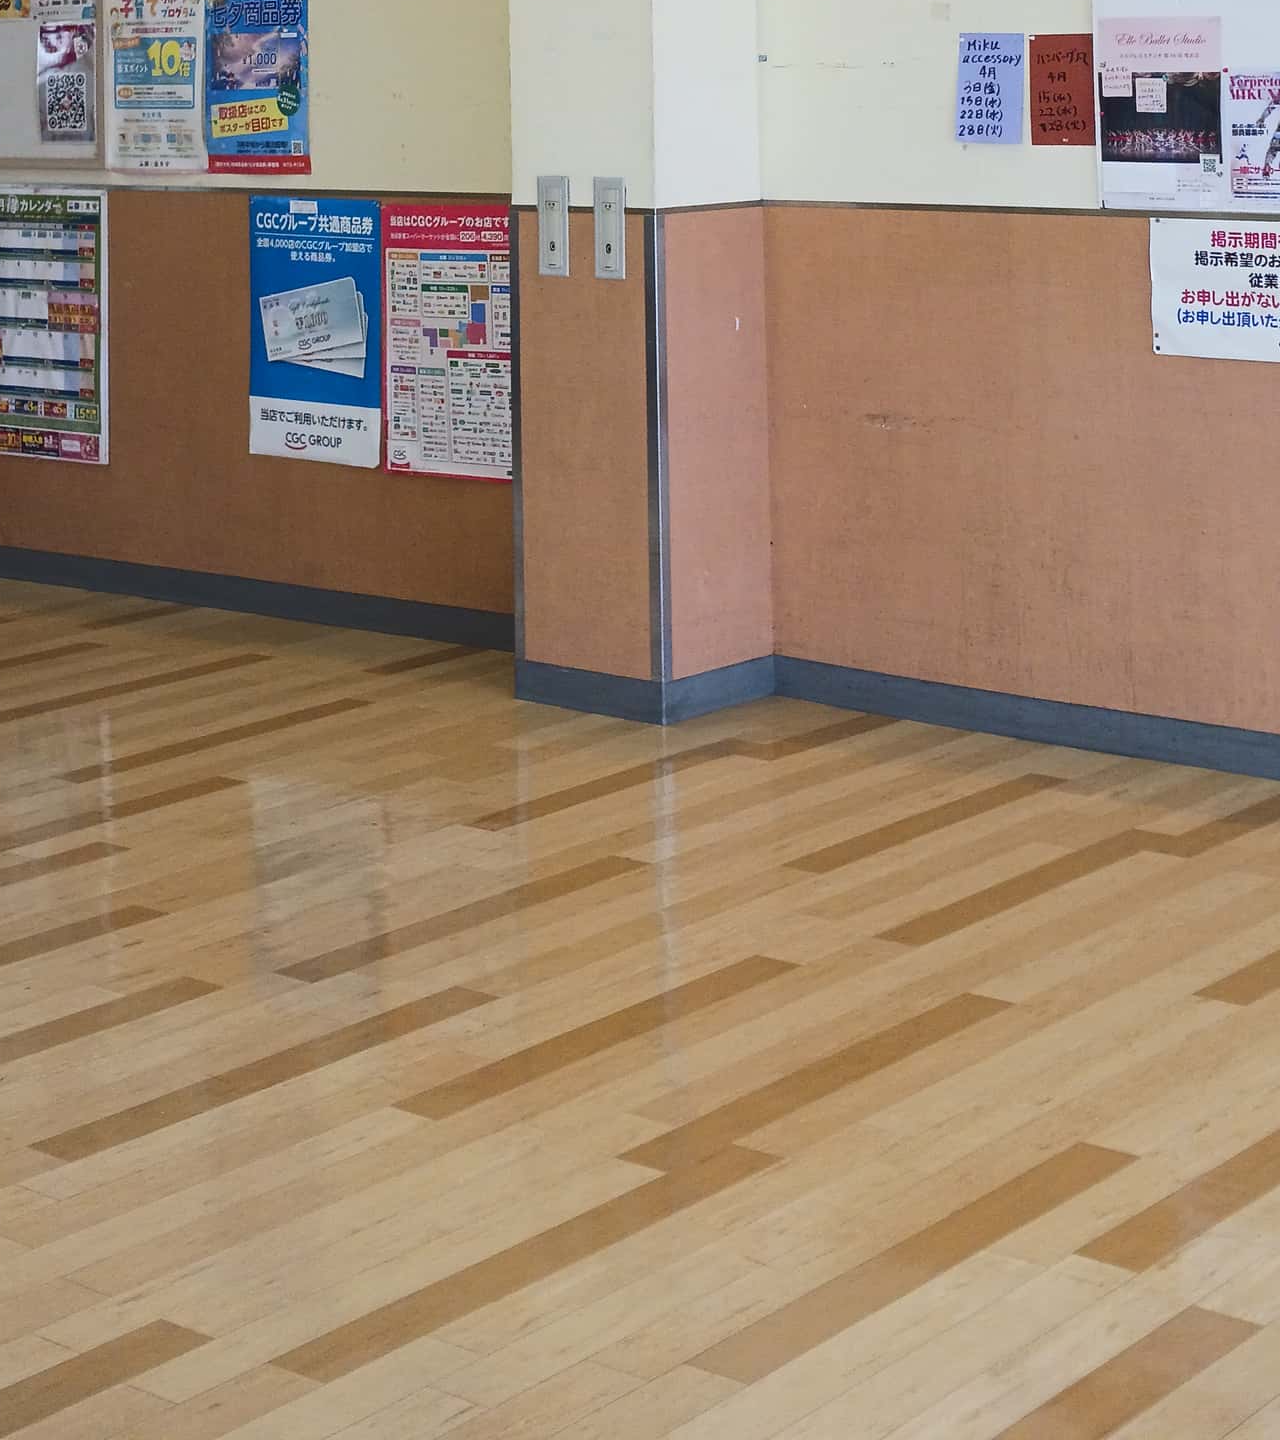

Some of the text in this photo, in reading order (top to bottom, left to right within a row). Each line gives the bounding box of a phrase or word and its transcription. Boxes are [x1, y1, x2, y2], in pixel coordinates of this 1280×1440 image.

[160, 7, 196, 18] プログラム
[962, 53, 1022, 67] accessory
[978, 65, 997, 81] 4月
[256, 212, 374, 236] CGCグループ共通商品券
[260, 407, 369, 432] 当店でご利用いただけます。
[285, 431, 343, 449] CGC GROUP
